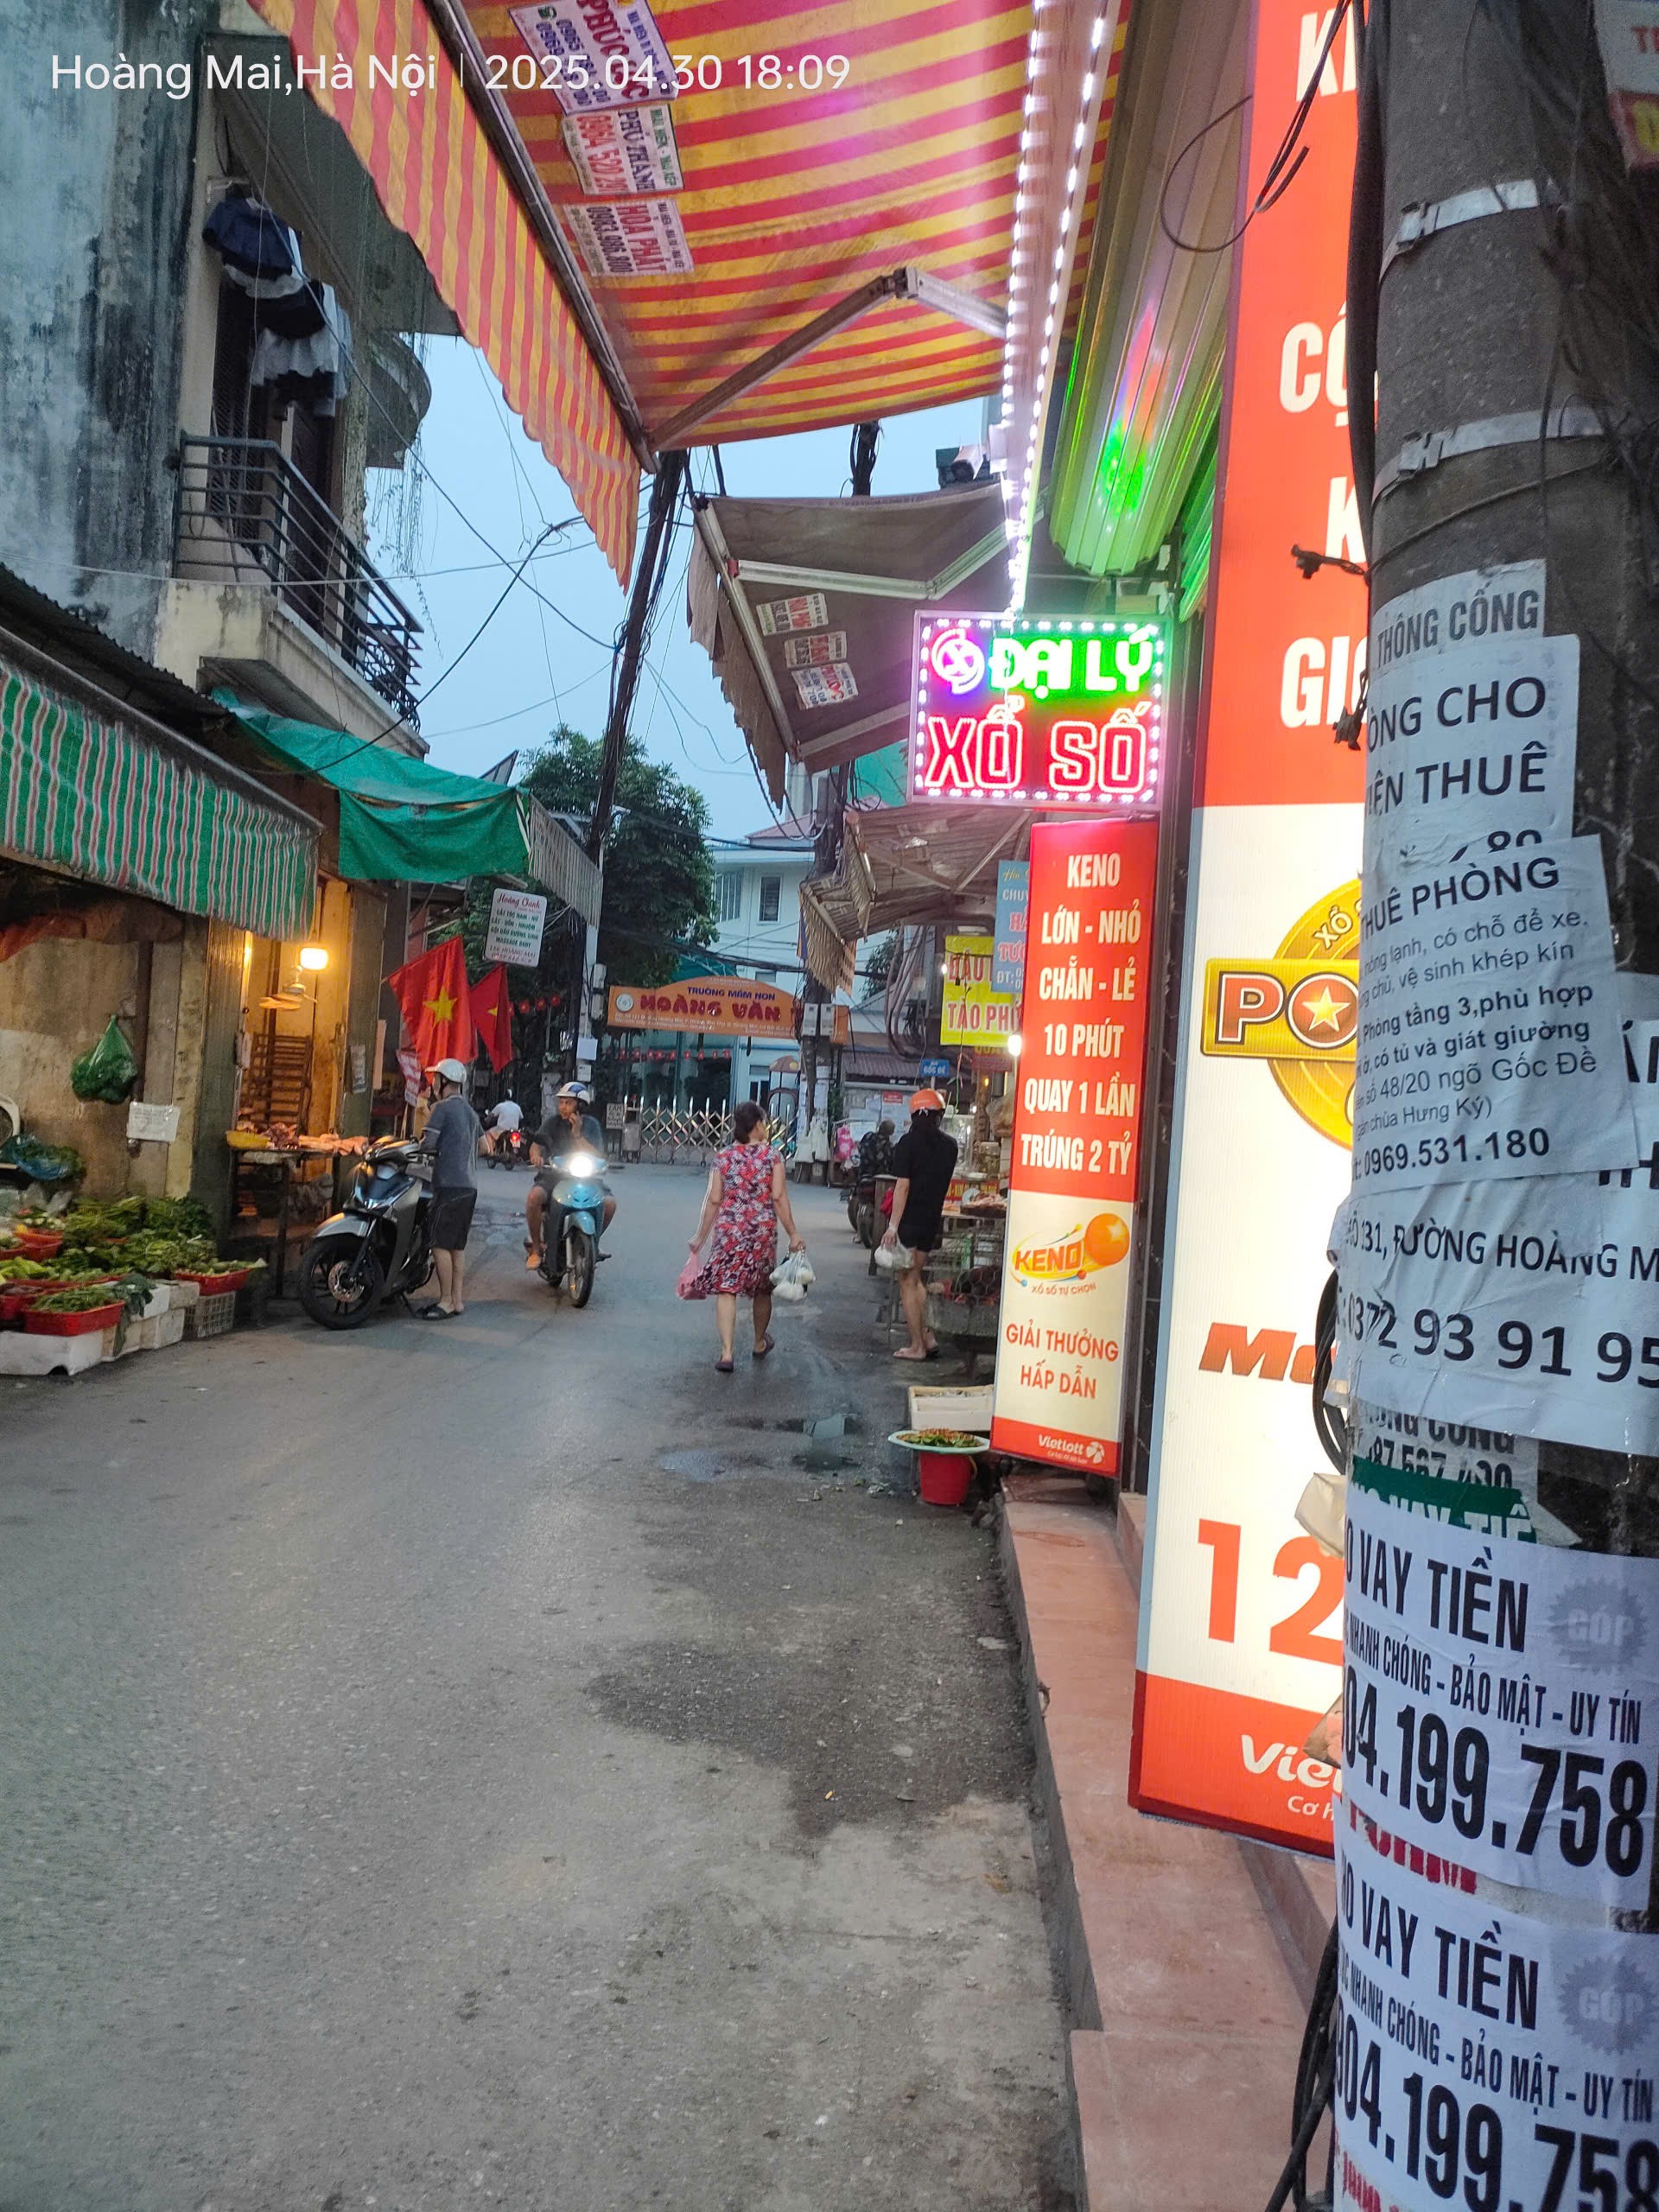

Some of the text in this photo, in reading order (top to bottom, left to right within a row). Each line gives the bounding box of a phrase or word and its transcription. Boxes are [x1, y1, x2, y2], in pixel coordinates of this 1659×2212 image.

[1376, 581, 1539, 670] THÔNG CỐNG
[988, 625, 1153, 699] ĐẠI LÝ
[1437, 677, 1546, 727] CHO
[925, 695, 1152, 793] XỔ SỐ
[1415, 741, 1548, 804] THUÊ
[1066, 853, 1121, 888] KENO
[1412, 856, 1560, 917] PHÒNG
[497, 893, 541, 909] Hoàng Oanh
[1041, 904, 1080, 945] LỚN
[1098, 899, 1141, 944] NHỎ
[495, 937, 518, 945] MASSAGE
[1313, 904, 1354, 949] XỔ
[1389, 938, 1427, 964] lạnh,
[1433, 926, 1457, 949] có
[1464, 915, 1504, 943] chỗ
[1514, 908, 1543, 934] để
[1552, 911, 1588, 929] xe.
[1039, 957, 1094, 1001] CHẴN
[1112, 956, 1135, 1001] LẺ
[1398, 967, 1418, 988] vệ
[1424, 957, 1465, 982] sinh
[1472, 947, 1529, 977] khép
[1537, 942, 1574, 963] kín
[640, 994, 722, 1017] HOÀNG
[754, 992, 776, 1001] NON
[1406, 1002, 1450, 1027] tầng
[1539, 983, 1592, 1007] hợp
[1044, 1024, 1065, 1057] 10
[1071, 1017, 1124, 1058] PHÚT
[1394, 1020, 1590, 1064] tủ và giát giường
[1025, 1071, 1136, 1118] QUAY 1 LẦN
[1380, 1070, 1430, 1100] 48/20
[1439, 1062, 1481, 1090] ngõ
[1491, 1052, 1547, 1080] Gốc
[1555, 1045, 1597, 1074] Đề
[1403, 1104, 1449, 1123] Hưng
[1457, 1095, 1493, 1119] Ký)
[1020, 1128, 1133, 1175] TRÚNG 2 TỶ
[1364, 1127, 1549, 1177] 0969.531.180
[1014, 1240, 1084, 1273] KENO
[1497, 1230, 1618, 1278] HOÀNG
[1006, 1319, 1119, 1363] GIẢI THƯỞNG
[1349, 1292, 1659, 1389] 0372 93 91 95
[1020, 1359, 1096, 1399] HẤP DẪN
[1038, 1433, 1085, 1456] Vietlott
[1360, 1529, 1413, 1616] VAY
[1427, 1547, 1529, 1653] TIỀN
[1350, 1613, 1380, 1670] NHANH
[1383, 1635, 1432, 1695] CHÓNG
[1450, 1652, 1491, 1716] BẢO
[1497, 1673, 1547, 1736] MẬT
[1552, 1712, 1563, 1721] -
[1570, 1690, 1600, 1738] UY
[1608, 1688, 1642, 1745] TÍN
[1343, 1664, 1648, 1878] 04.199.758
[1287, 1796, 1319, 1815] Cơ
[1361, 1880, 1418, 1979] VAY
[1434, 1920, 1539, 2031] TIỀN
[1351, 1961, 1382, 2030] NHANH
[1387, 2000, 1440, 2066] CHÓNG
[1460, 2027, 1503, 2093] BẢO
[1510, 2052, 1559, 2115] MẬT
[1565, 2091, 1577, 2101] -
[1584, 2071, 1613, 2120] UY
[1622, 2068, 1654, 2123] TÍN
